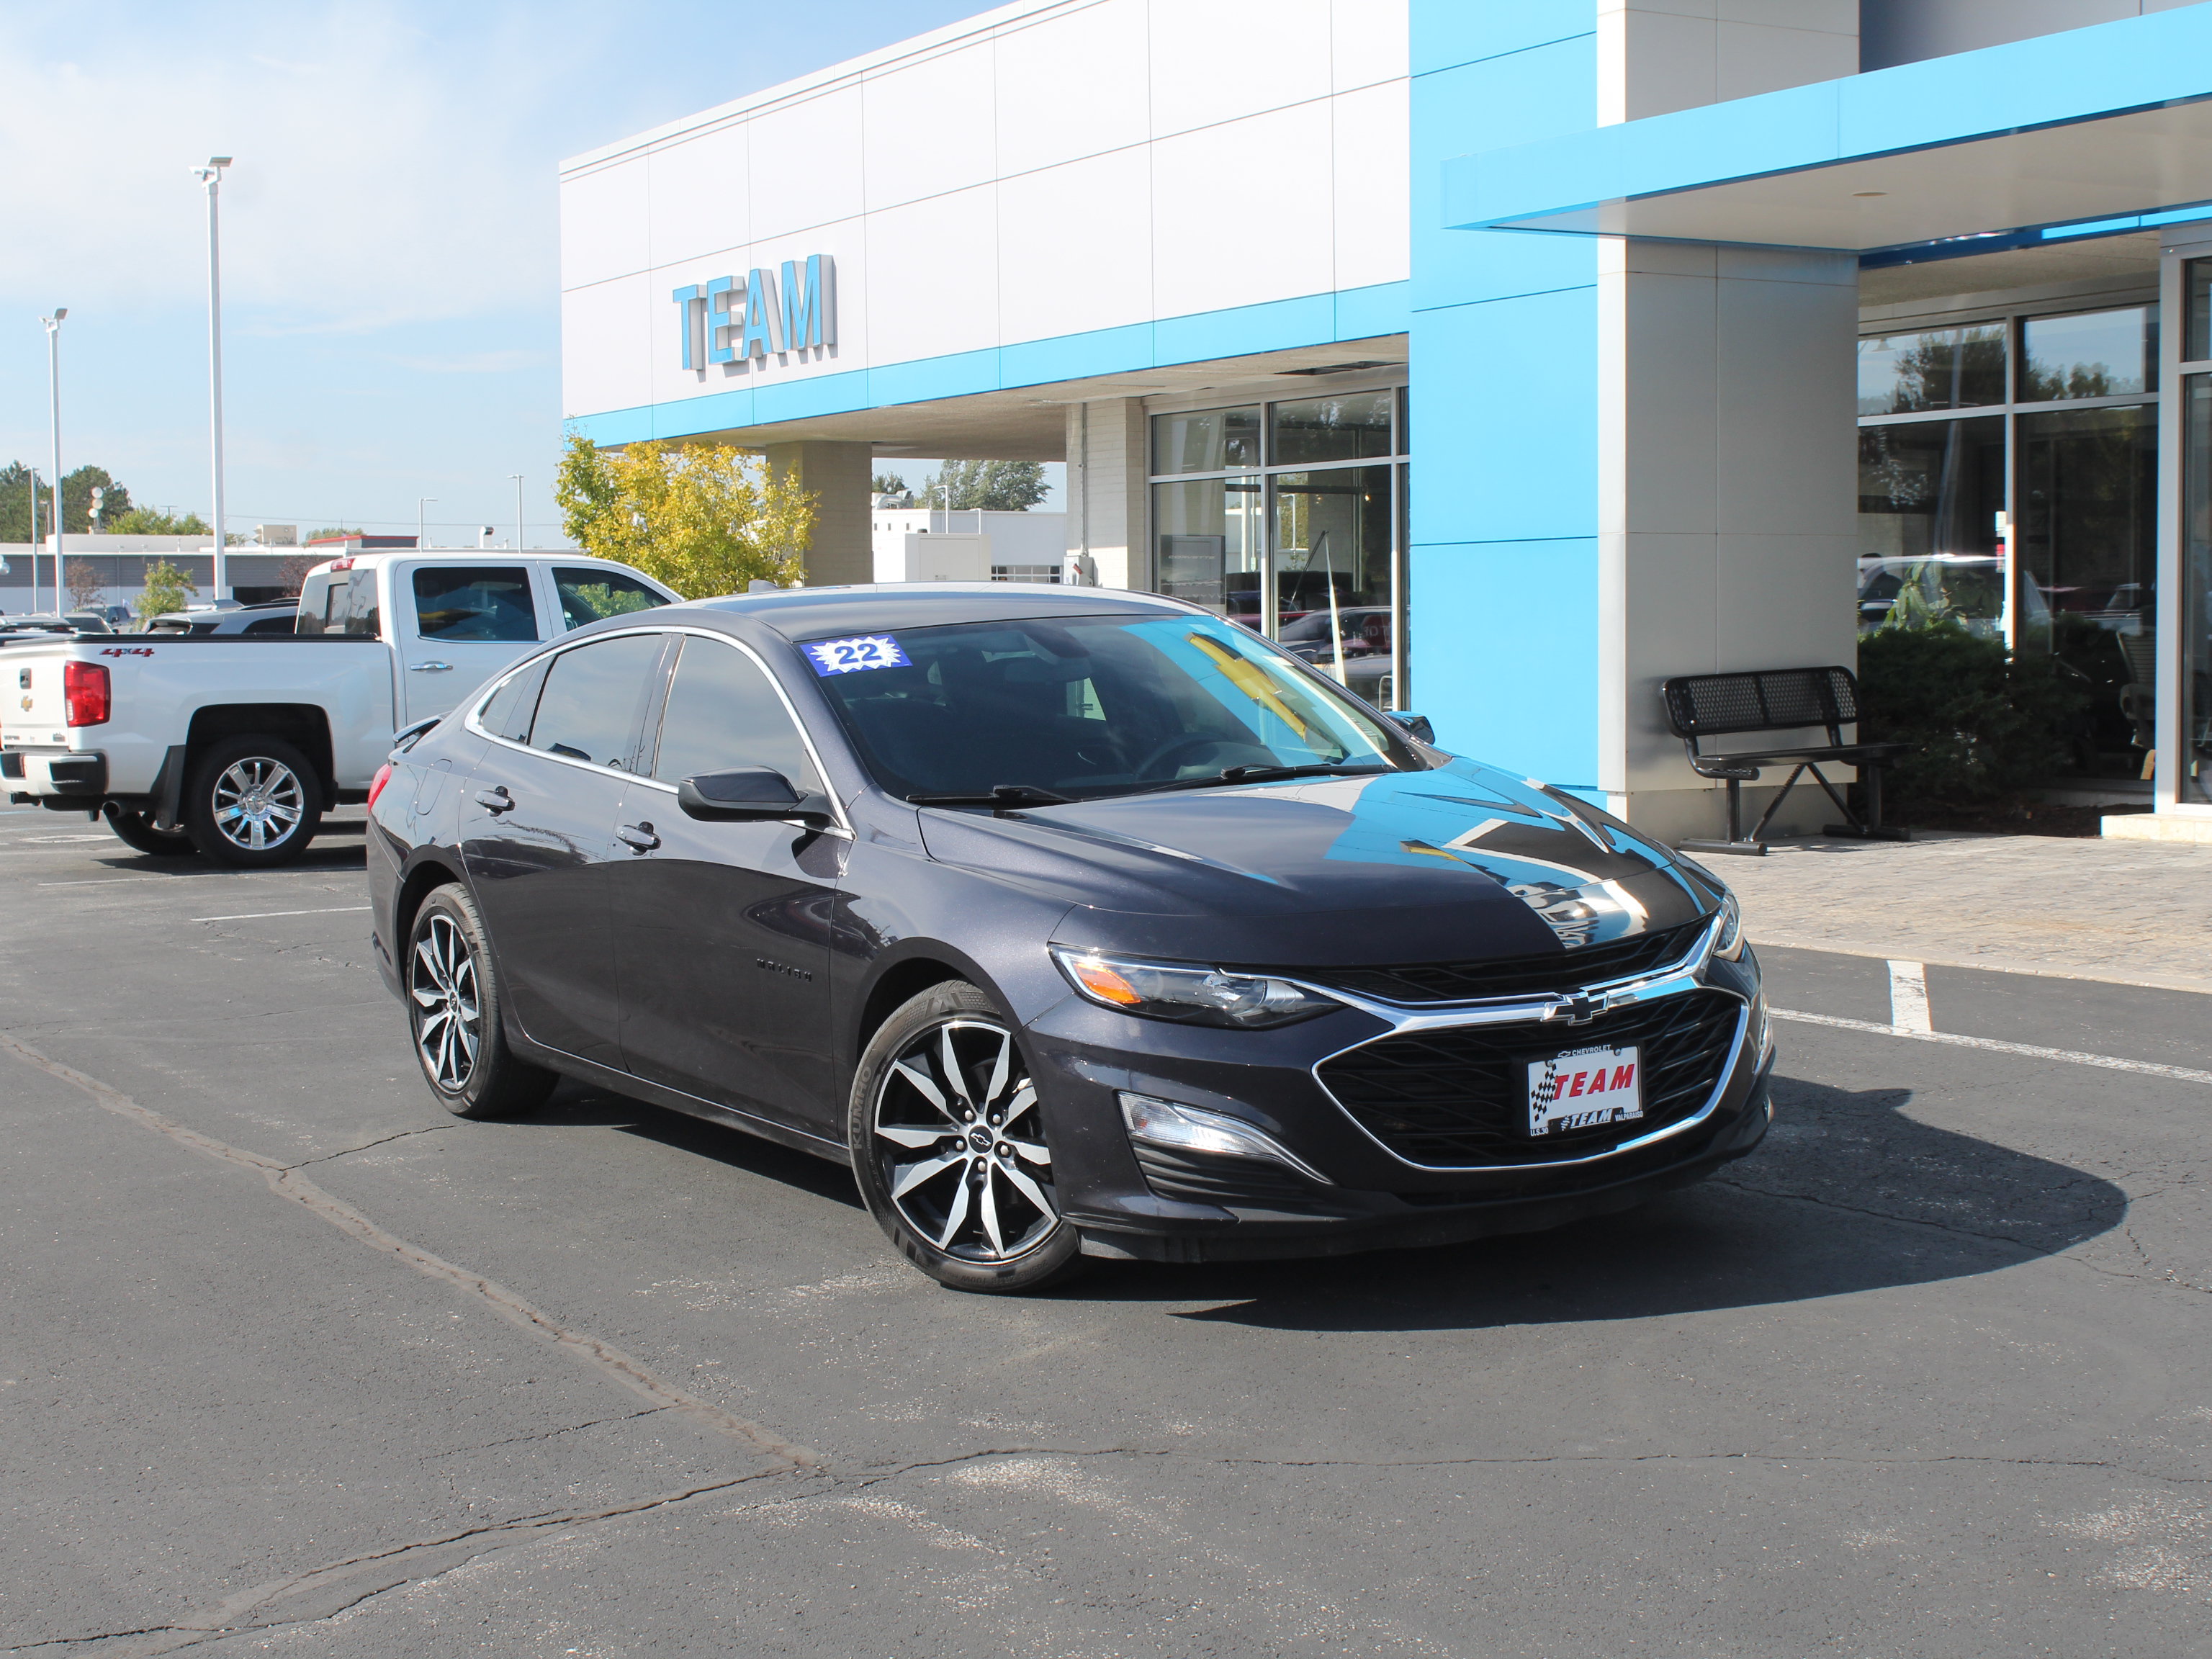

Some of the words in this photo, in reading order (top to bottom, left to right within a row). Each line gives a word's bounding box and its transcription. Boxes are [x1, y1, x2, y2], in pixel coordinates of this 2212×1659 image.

[673, 253, 834, 370] TEAM
[834, 643, 883, 664] 22
[1572, 1044, 1611, 1057] CHEVROLET
[1552, 1064, 1635, 1101] TEAM
[852, 1066, 872, 1150] KUMHO
[1570, 1108, 1613, 1128] TEAM
[1614, 1110, 1643, 1122] VALPARAISO
